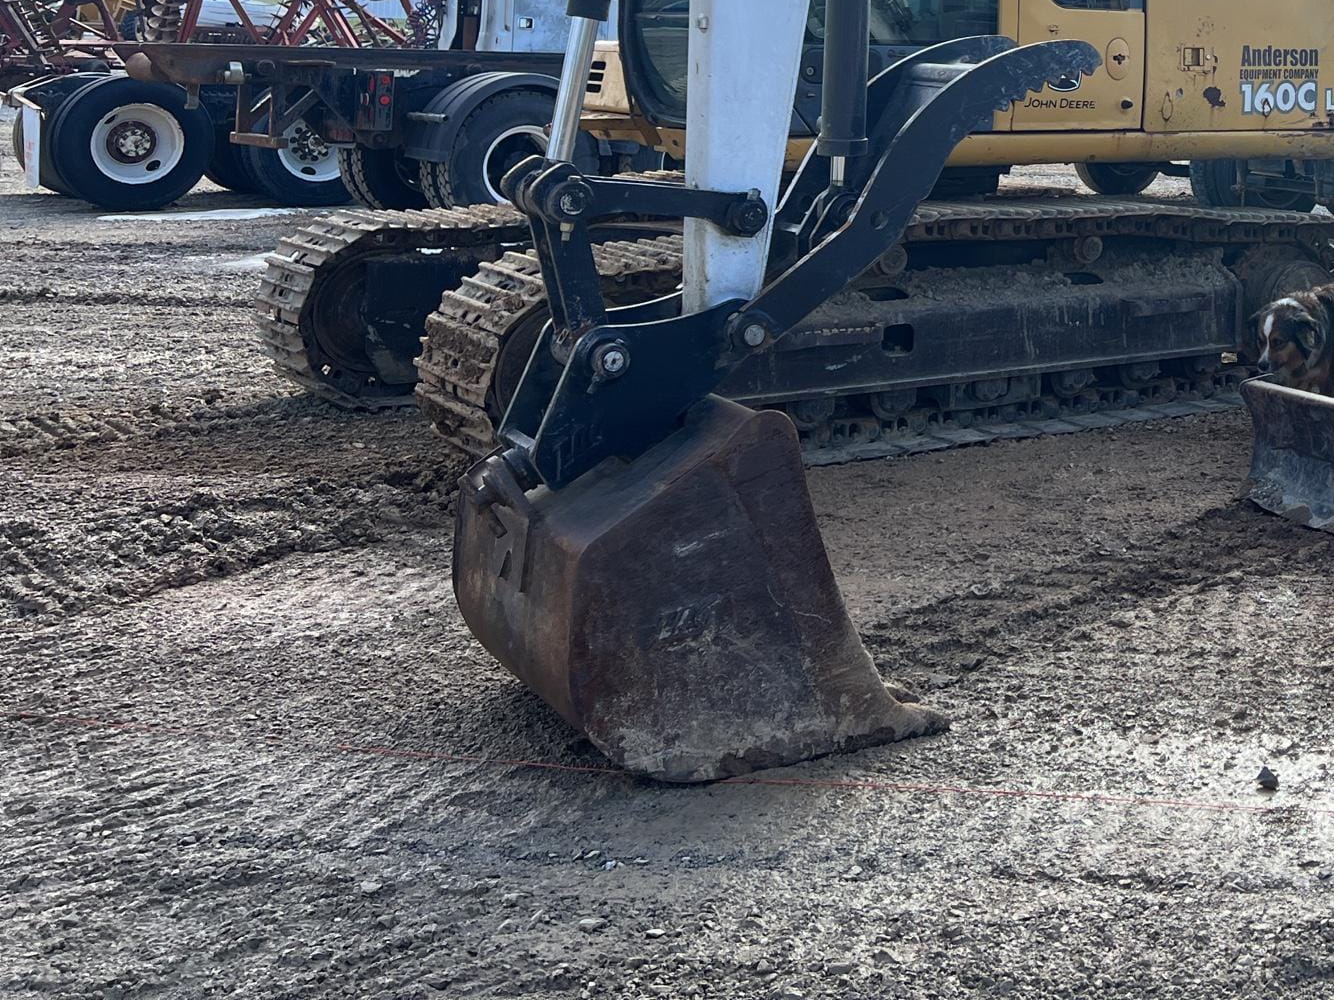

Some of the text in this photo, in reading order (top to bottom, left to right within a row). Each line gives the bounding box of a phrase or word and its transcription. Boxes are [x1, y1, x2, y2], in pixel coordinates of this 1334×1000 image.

[1241, 45, 1319, 67] Anderson
[1240, 68, 1319, 80] EQUIPMENT COMPANY
[1240, 81, 1317, 114] 160C
